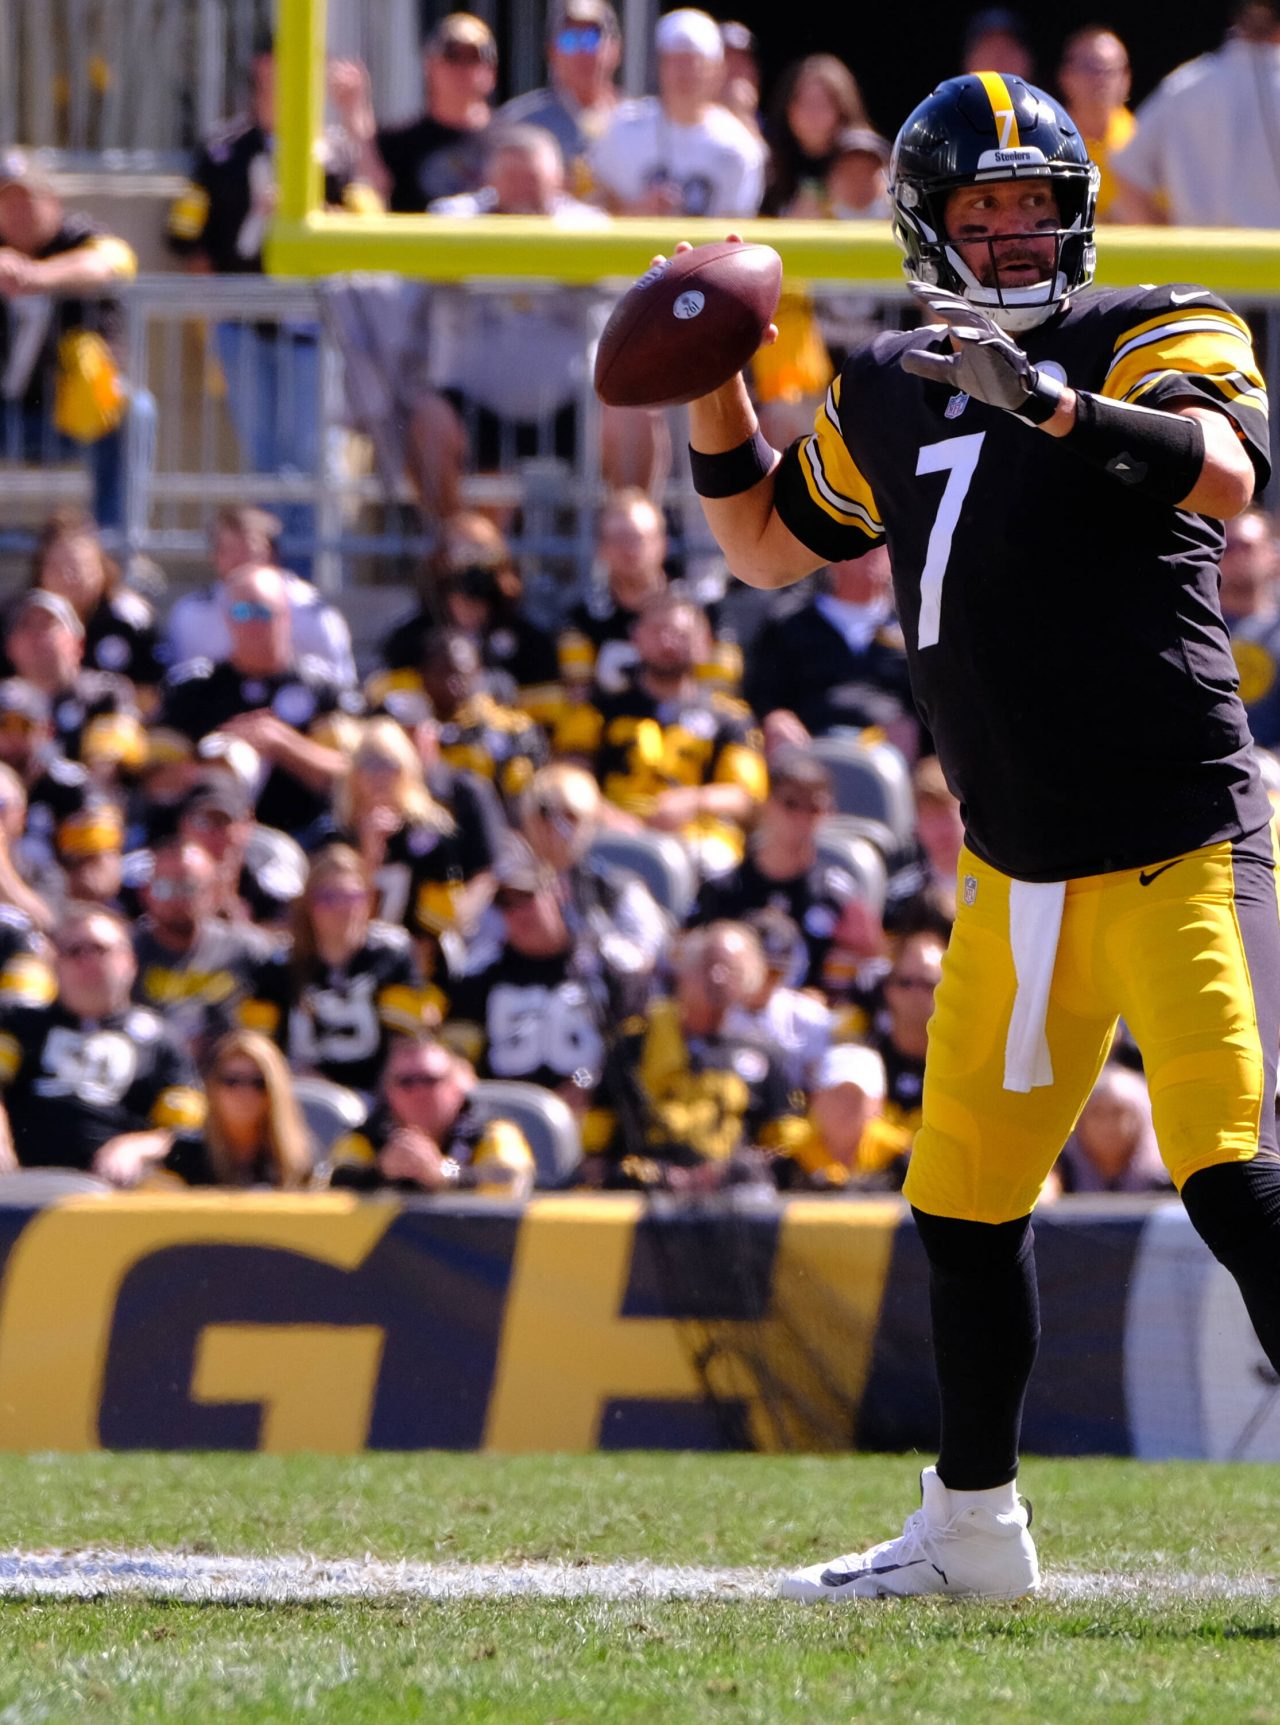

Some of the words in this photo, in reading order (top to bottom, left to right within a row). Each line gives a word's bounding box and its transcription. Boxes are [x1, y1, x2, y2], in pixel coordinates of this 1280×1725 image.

[995, 109, 1015, 149] 7
[994, 151, 1031, 162] Steelers
[915, 430, 987, 650] 7
